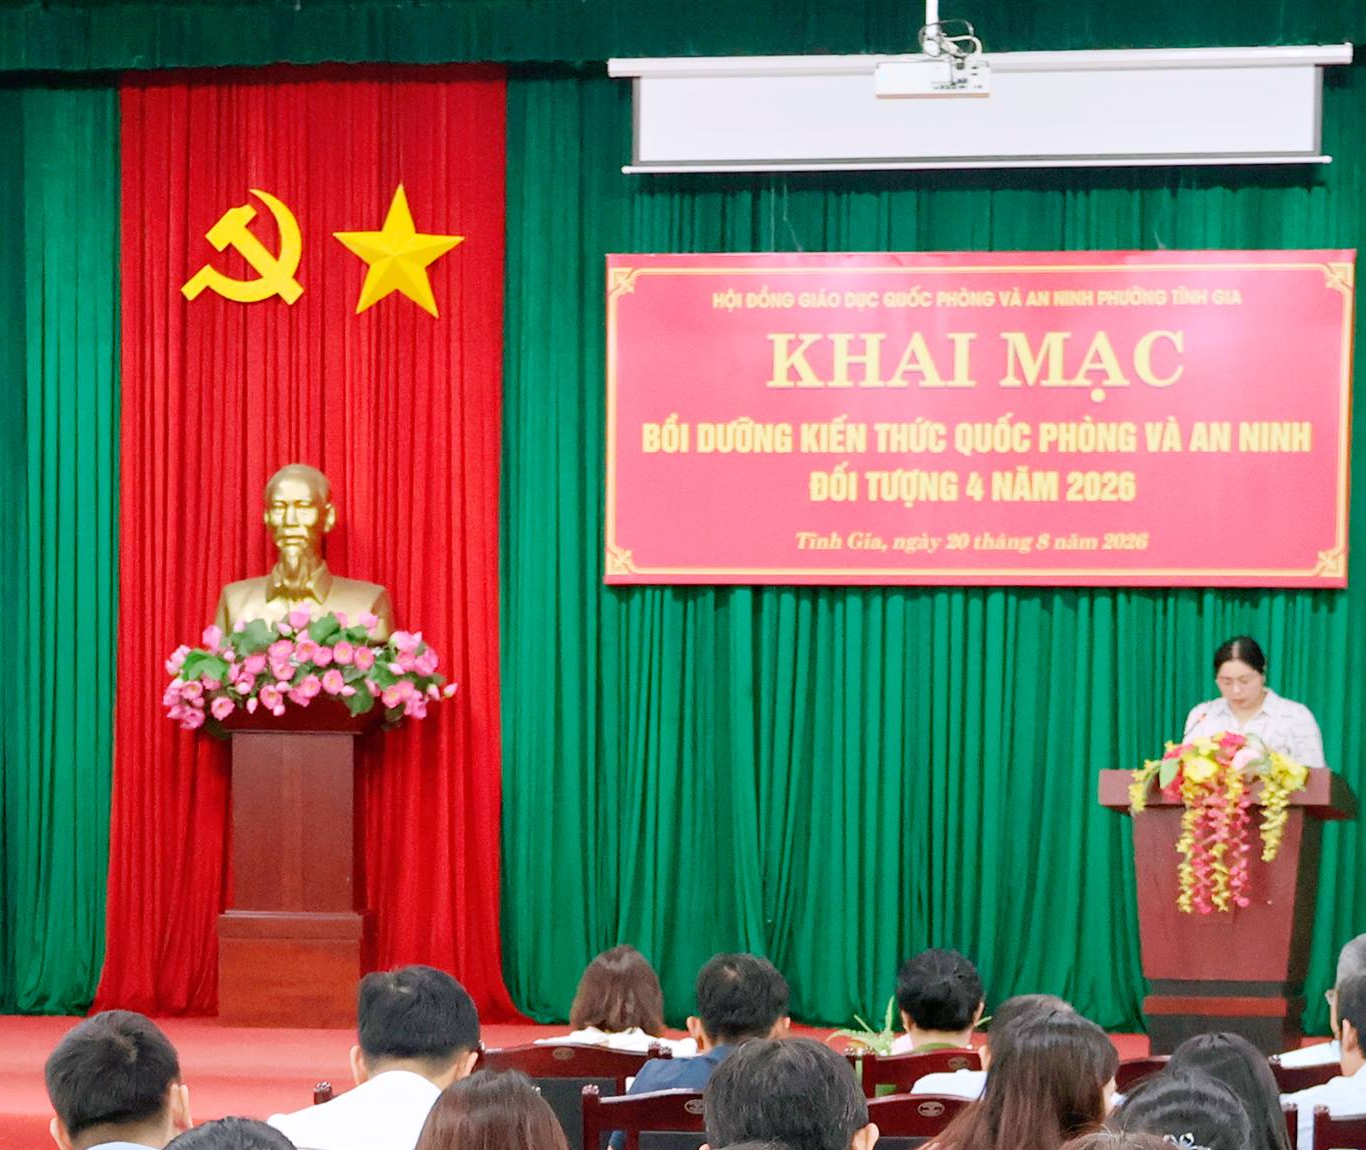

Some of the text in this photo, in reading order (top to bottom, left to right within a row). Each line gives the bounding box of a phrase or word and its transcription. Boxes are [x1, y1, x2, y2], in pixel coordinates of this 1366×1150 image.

[767, 329, 1185, 402] KHAI MẠC
[642, 412, 1311, 456] BỒI DƯỠNG KIẾN THỨC QUỐC PHÒNG VÀ AN NINH
[809, 461, 1136, 508] ĐỐI TƯỢNG 4 NĂM 2026
[796, 532, 1149, 554] Tĩnh Gia, ngày 20 tháng 8 năm 2026
